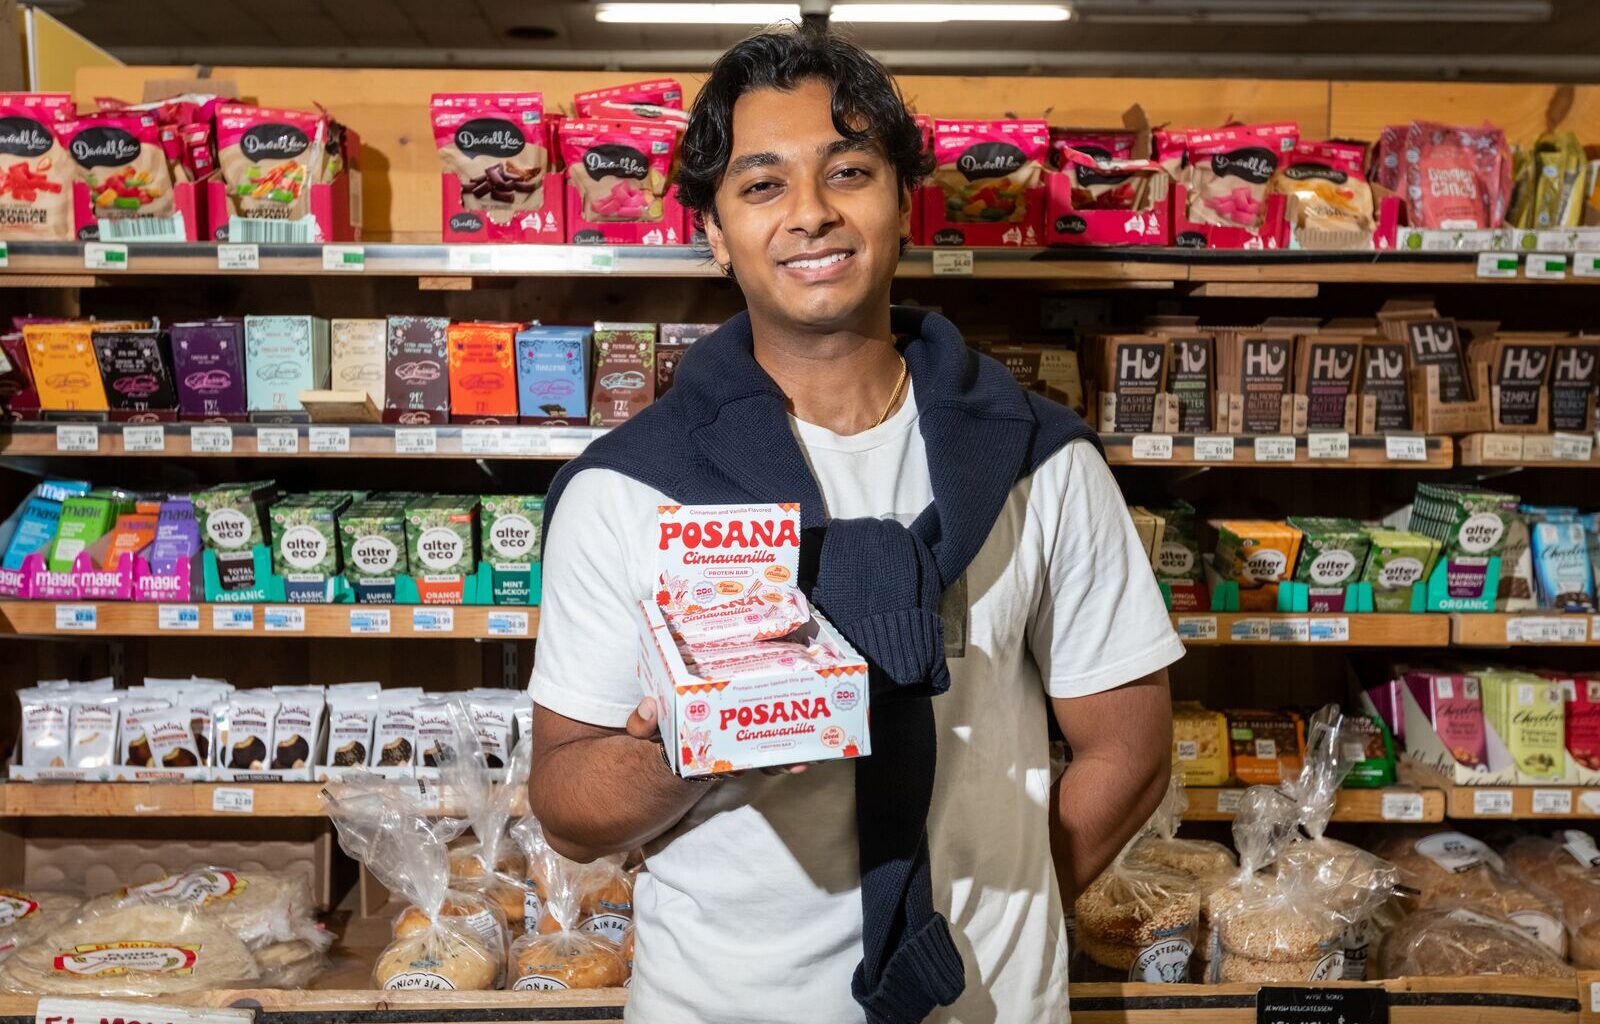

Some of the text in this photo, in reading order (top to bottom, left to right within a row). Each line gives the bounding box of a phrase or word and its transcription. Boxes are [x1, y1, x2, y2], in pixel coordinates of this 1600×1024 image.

[212, 520, 245, 531] alter
[1465, 524, 1498, 535] alter
[218, 530, 243, 539] eco
[495, 527, 530, 538] alter
[658, 519, 800, 550] POSANA
[286, 538, 321, 549] alter
[500, 539, 526, 548] eco
[1466, 535, 1491, 544] eco
[422, 540, 457, 551] alter
[291, 550, 317, 559] eco
[357, 547, 391, 557] alter
[428, 551, 454, 560] eco
[363, 557, 388, 565] eco
[682, 550, 776, 566] Cinnavanilla
[1161, 560, 1186, 568] eco
[1248, 559, 1282, 569] alter
[1317, 560, 1350, 570] alter
[1250, 568, 1276, 576] eco
[1385, 566, 1419, 575] alter
[0, 571, 25, 587] agic
[36, 572, 78, 587] magic
[80, 572, 123, 587] magic
[139, 575, 181, 590] magic
[1386, 574, 1412, 582] eco
[215, 590, 265, 602] ORGANIC
[290, 591, 324, 599] CLASSIC
[1439, 600, 1488, 610] ORGANIC
[682, 606, 753, 624] Cinnavanilla
[719, 697, 832, 731] POSANA
[736, 723, 816, 742] Cinnavanilla
